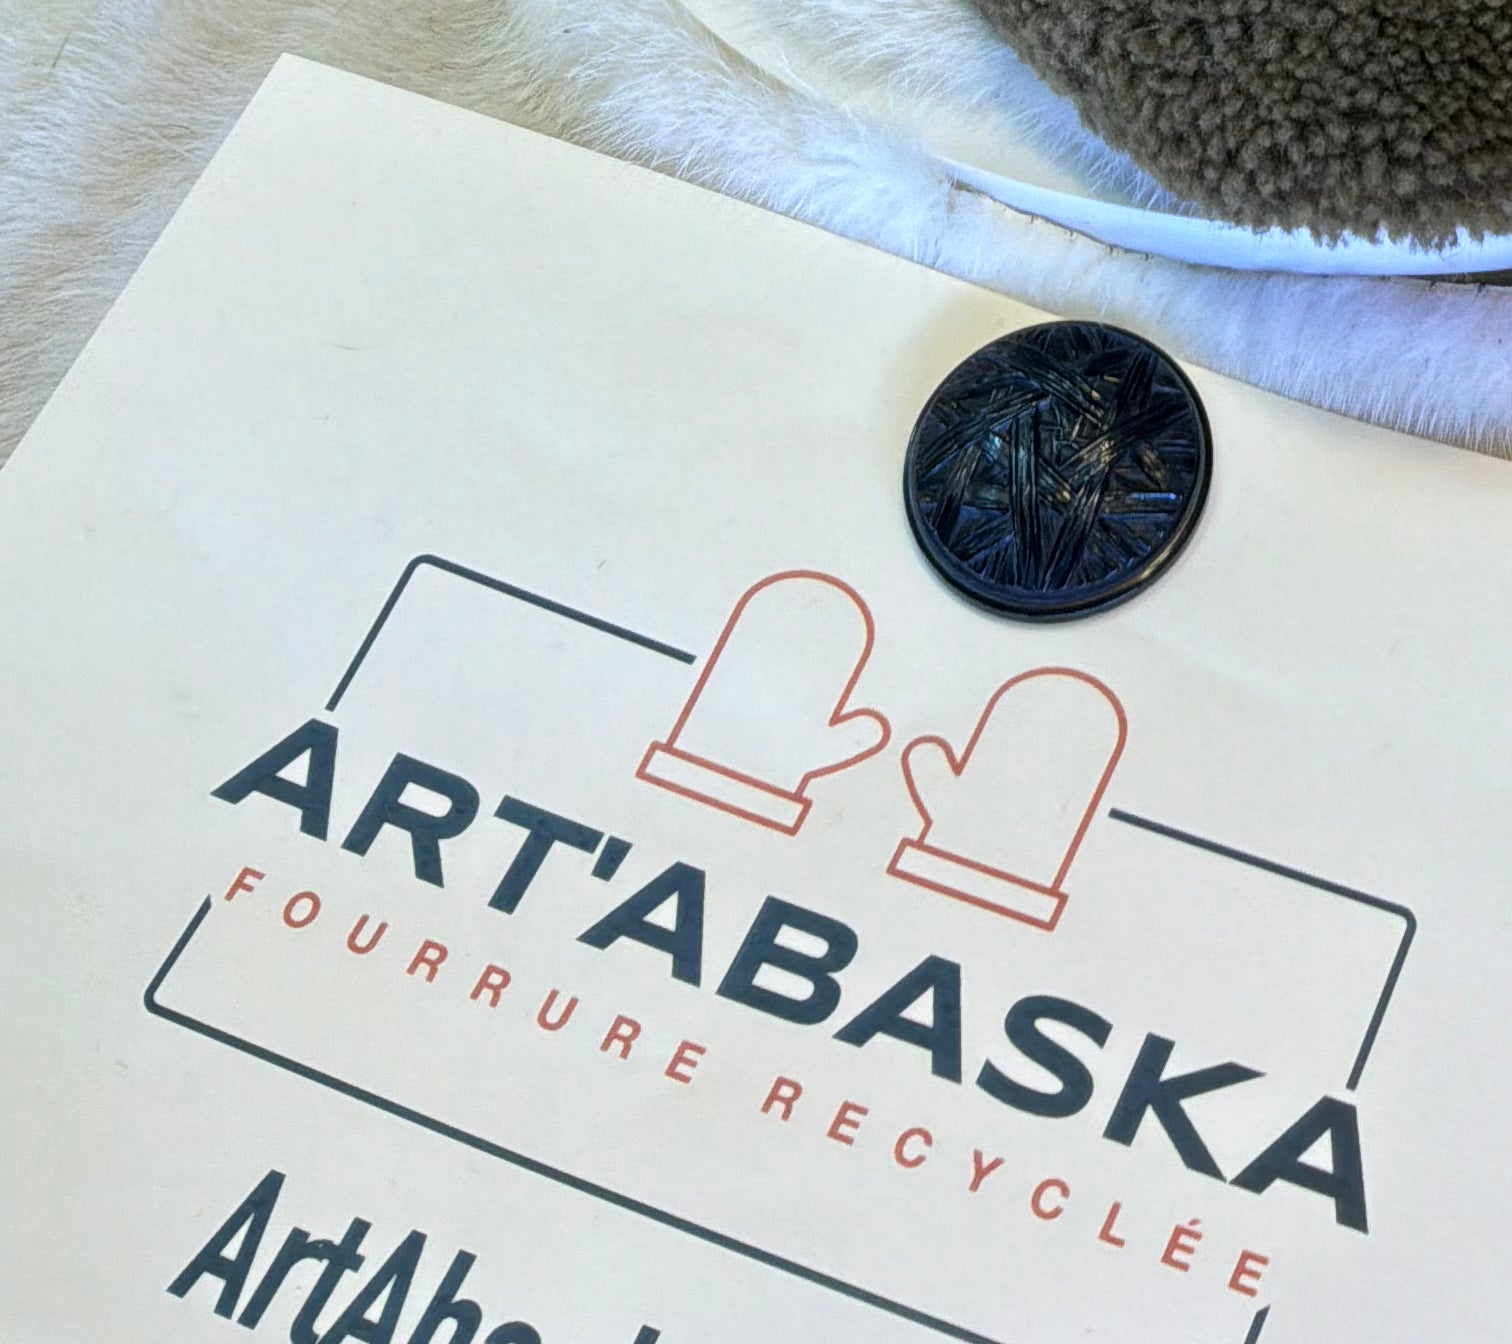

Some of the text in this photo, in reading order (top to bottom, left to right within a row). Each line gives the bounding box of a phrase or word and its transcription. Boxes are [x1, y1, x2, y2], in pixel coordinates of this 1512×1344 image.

[210, 717, 1369, 1234] ART'ABASKA
[224, 866, 1270, 1297] FOURRURE RECYCLÉE
